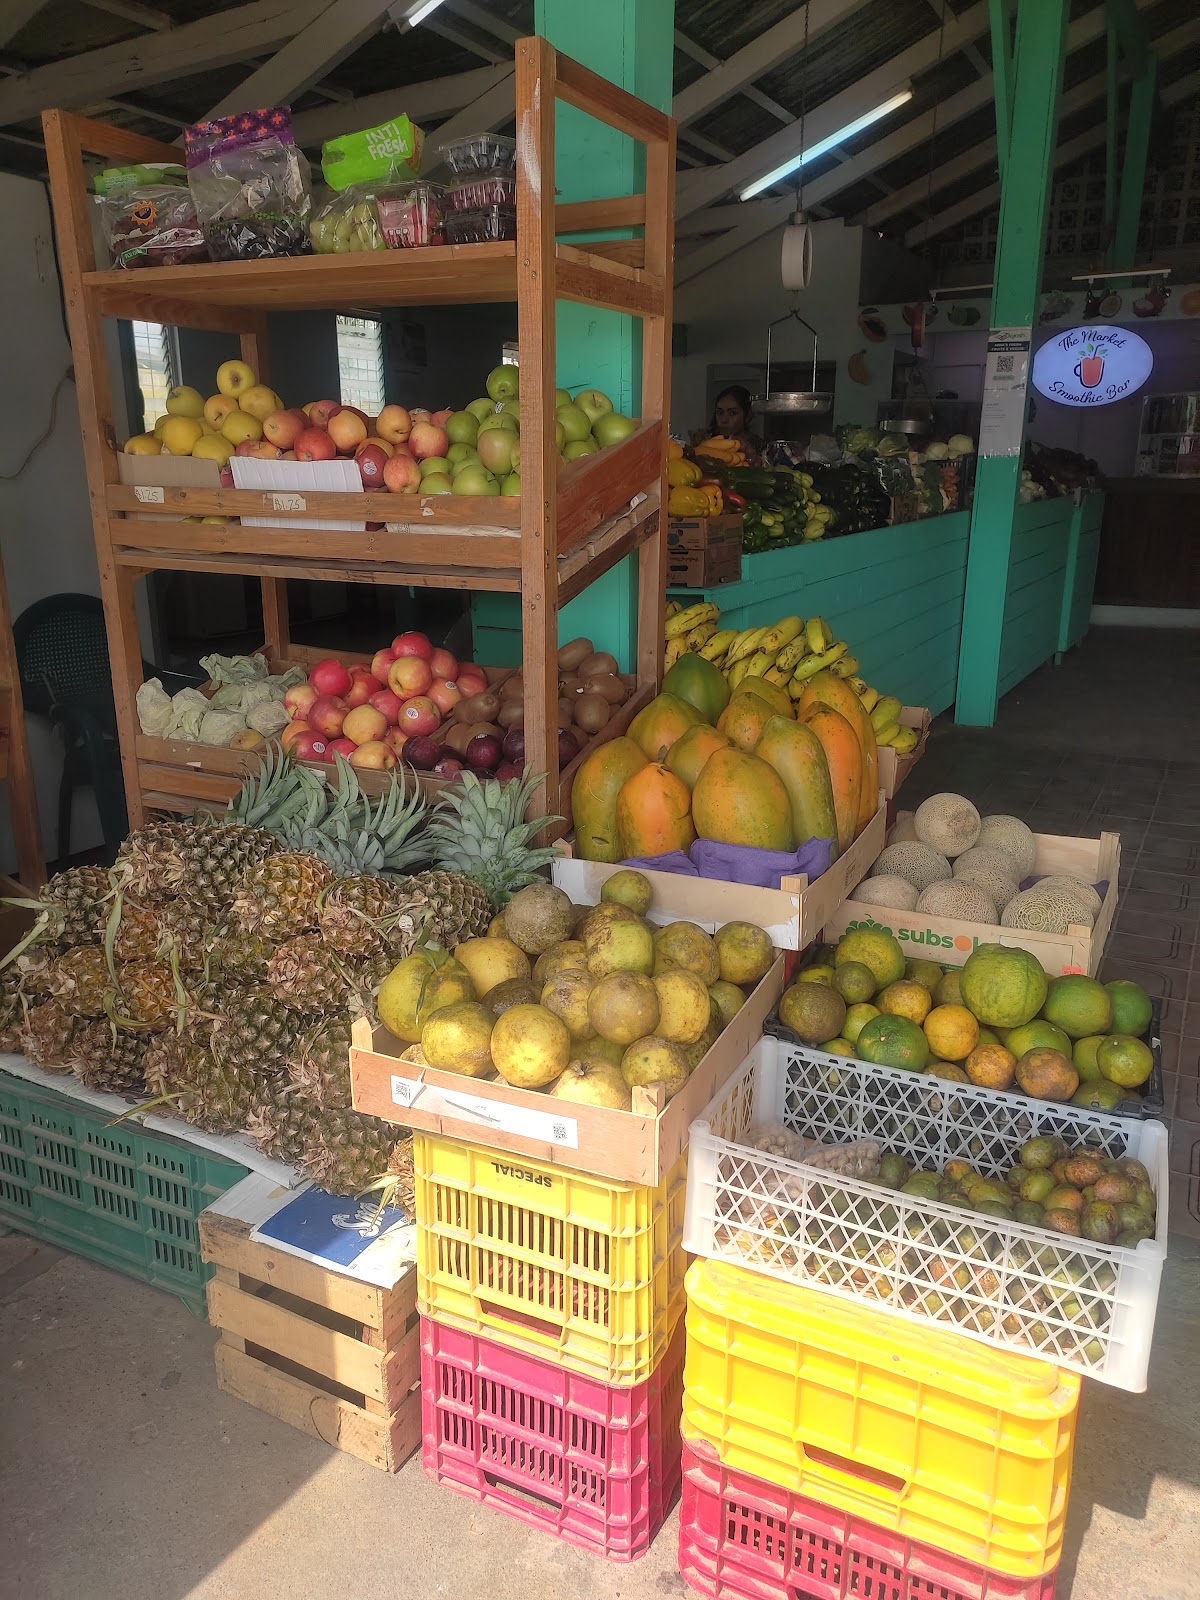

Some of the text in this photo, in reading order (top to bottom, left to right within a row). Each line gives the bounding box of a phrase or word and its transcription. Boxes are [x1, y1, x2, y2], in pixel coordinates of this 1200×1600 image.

[365, 122, 400, 145] INTI
[1058, 330, 1127, 352] The Market
[1048, 379, 1130, 404] Smoothie Bar
[490, 1161, 553, 1188] SPECIAL
